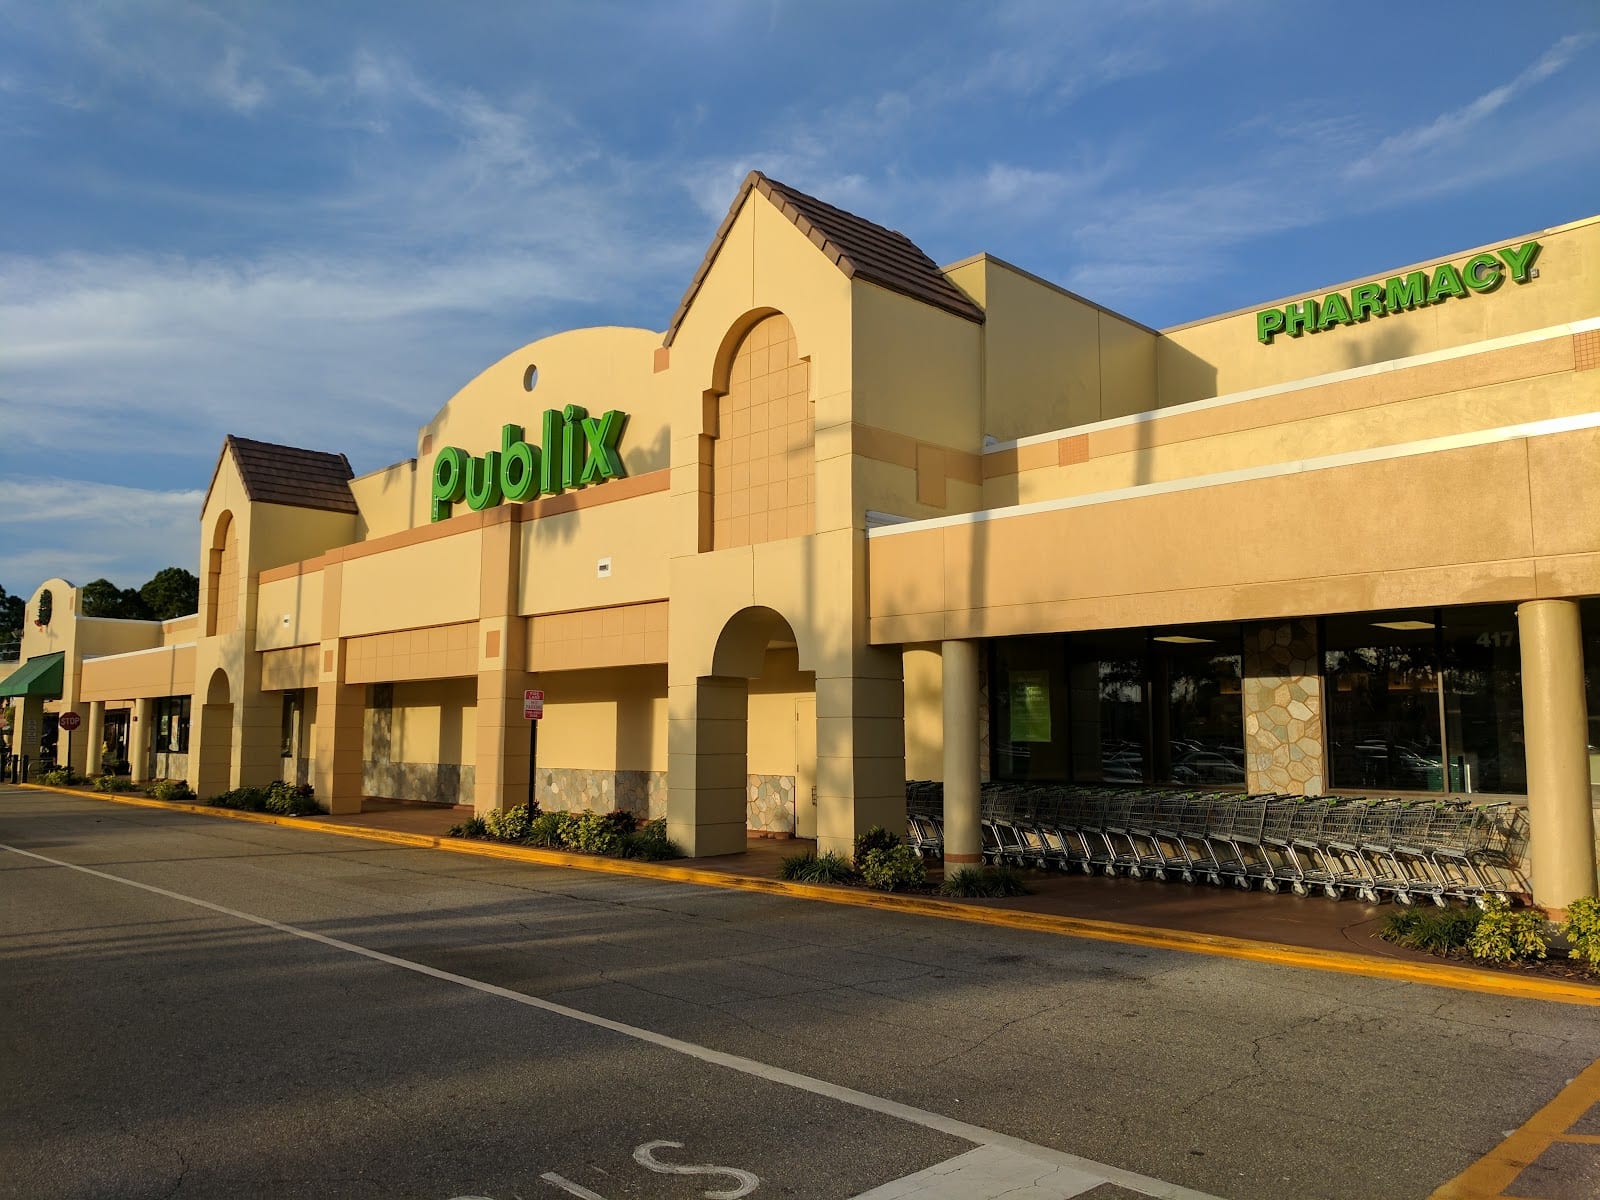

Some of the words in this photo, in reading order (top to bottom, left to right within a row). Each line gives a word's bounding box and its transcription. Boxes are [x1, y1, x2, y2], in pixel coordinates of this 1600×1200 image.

[1257, 241, 1544, 343] PHARMACY
[431, 404, 627, 522] Publix
[1476, 631, 1514, 648] 417
[60, 717, 81, 726] STOP
